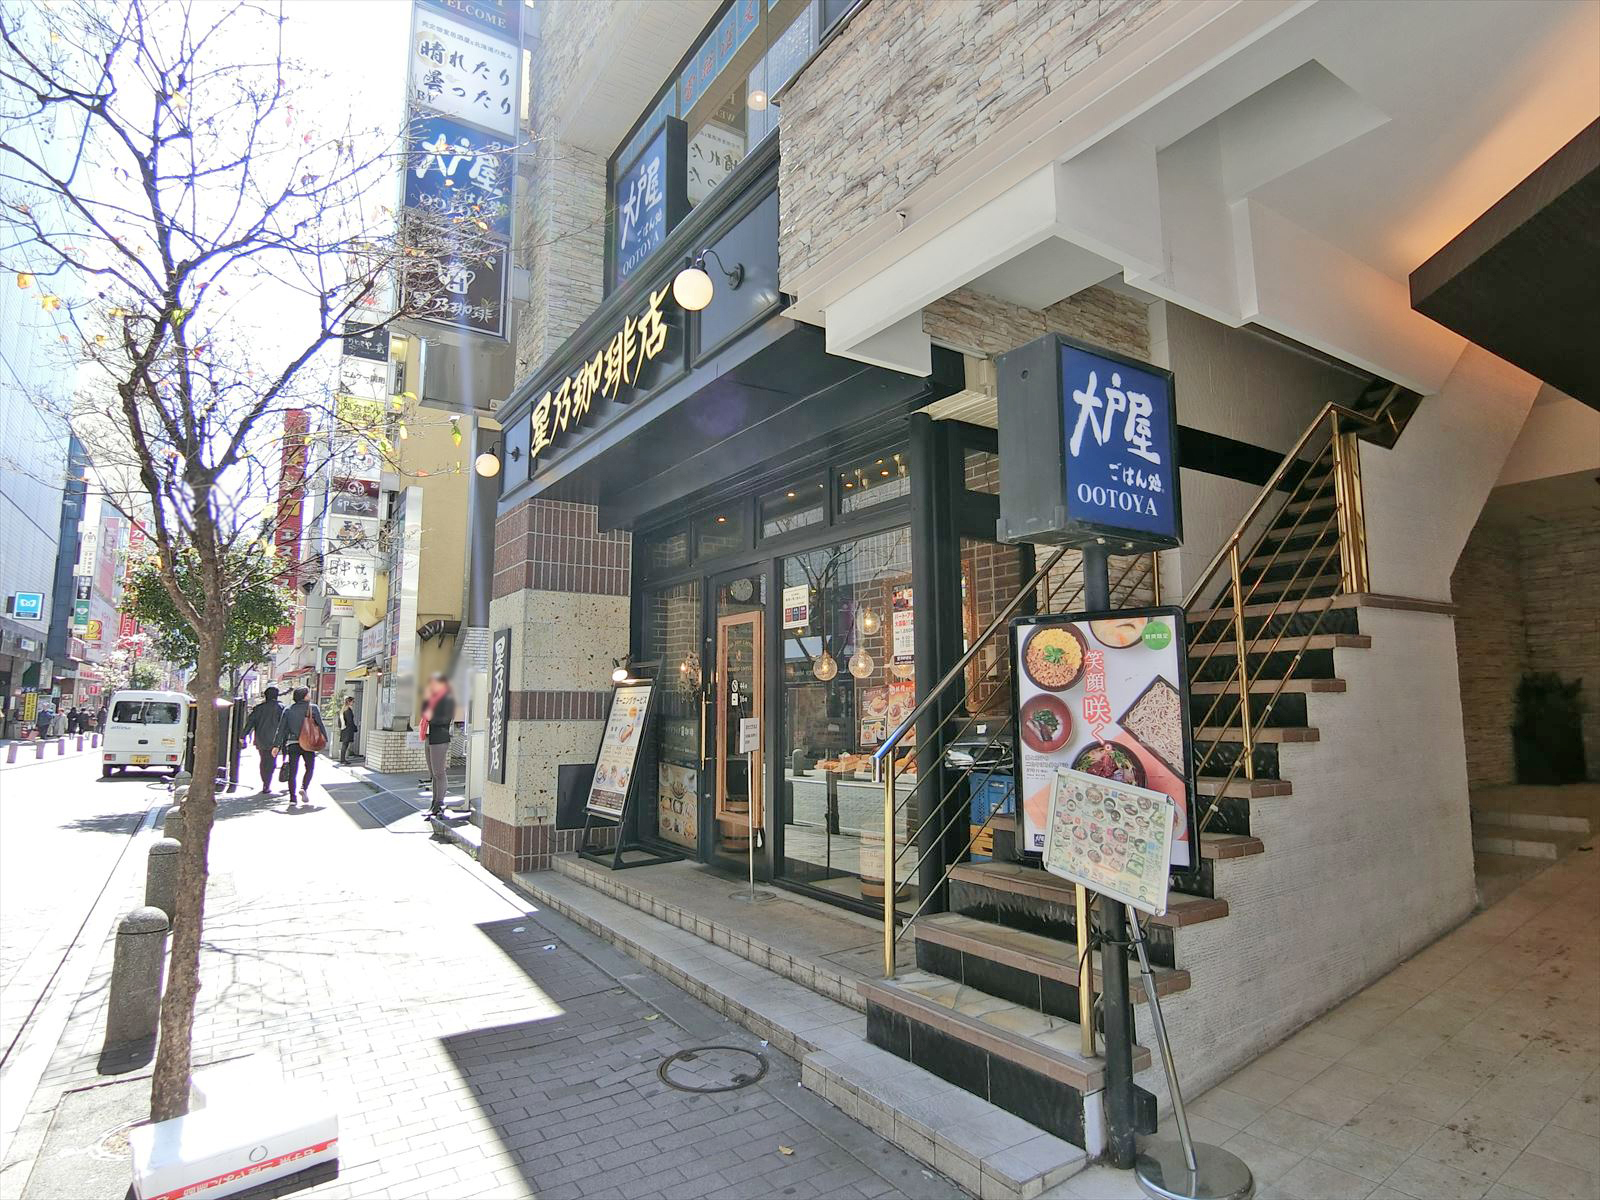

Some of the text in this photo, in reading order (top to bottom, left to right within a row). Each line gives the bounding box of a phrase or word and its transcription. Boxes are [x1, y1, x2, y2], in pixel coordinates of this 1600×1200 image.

[420, 41, 510, 86] 晴れたり
[423, 69, 511, 115] 曇ったり
[621, 156, 663, 250] 大戸屋
[622, 235, 660, 275] OOTOYA
[531, 282, 671, 458] 星乃珈琲店
[1069, 370, 1161, 465] 大戸屋
[1077, 483, 1158, 516] OOTOYA
[1108, 463, 1162, 493] ごはん処
[489, 635, 506, 774] 星乃珈琲店
[1083, 649, 1114, 752] 笑顔咲く。
